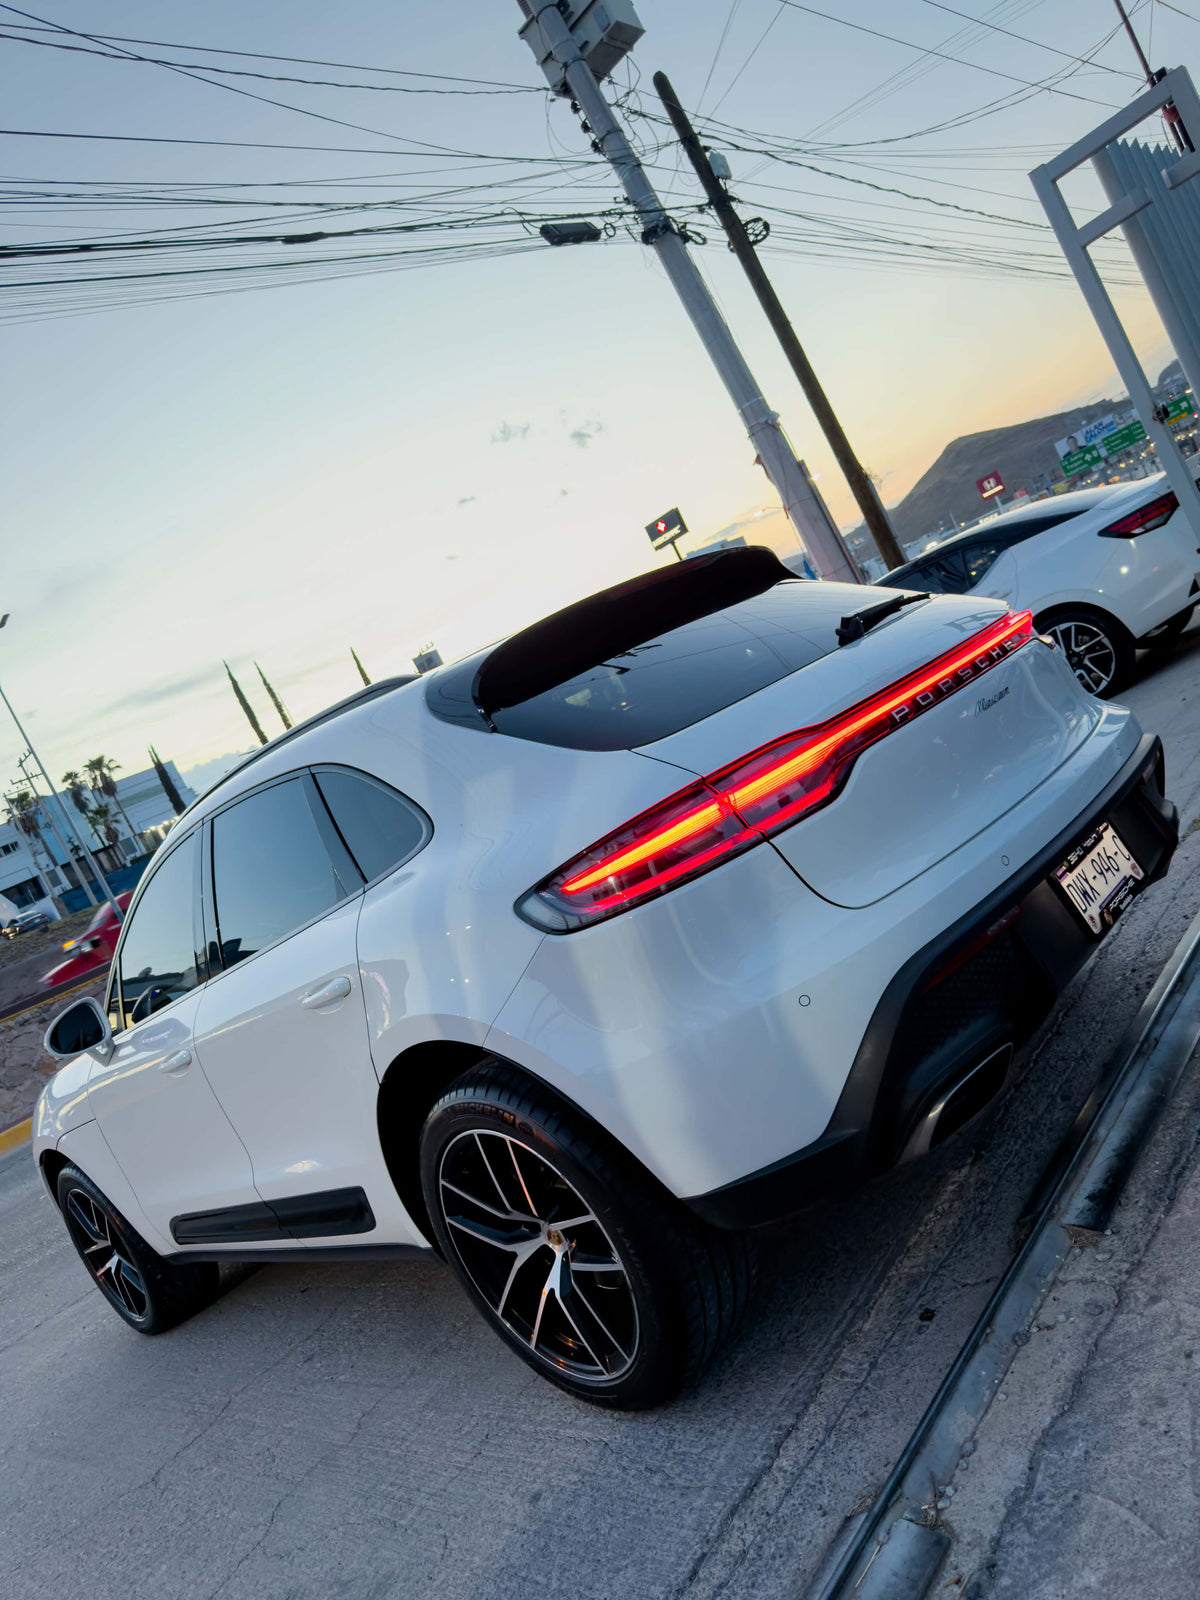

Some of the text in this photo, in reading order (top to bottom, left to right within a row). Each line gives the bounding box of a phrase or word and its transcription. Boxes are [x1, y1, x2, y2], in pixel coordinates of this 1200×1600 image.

[891, 637, 1018, 722] PORSCHE
[1066, 834, 1131, 914] DWX-946-C
[1108, 878, 1136, 912] PORSCHE
